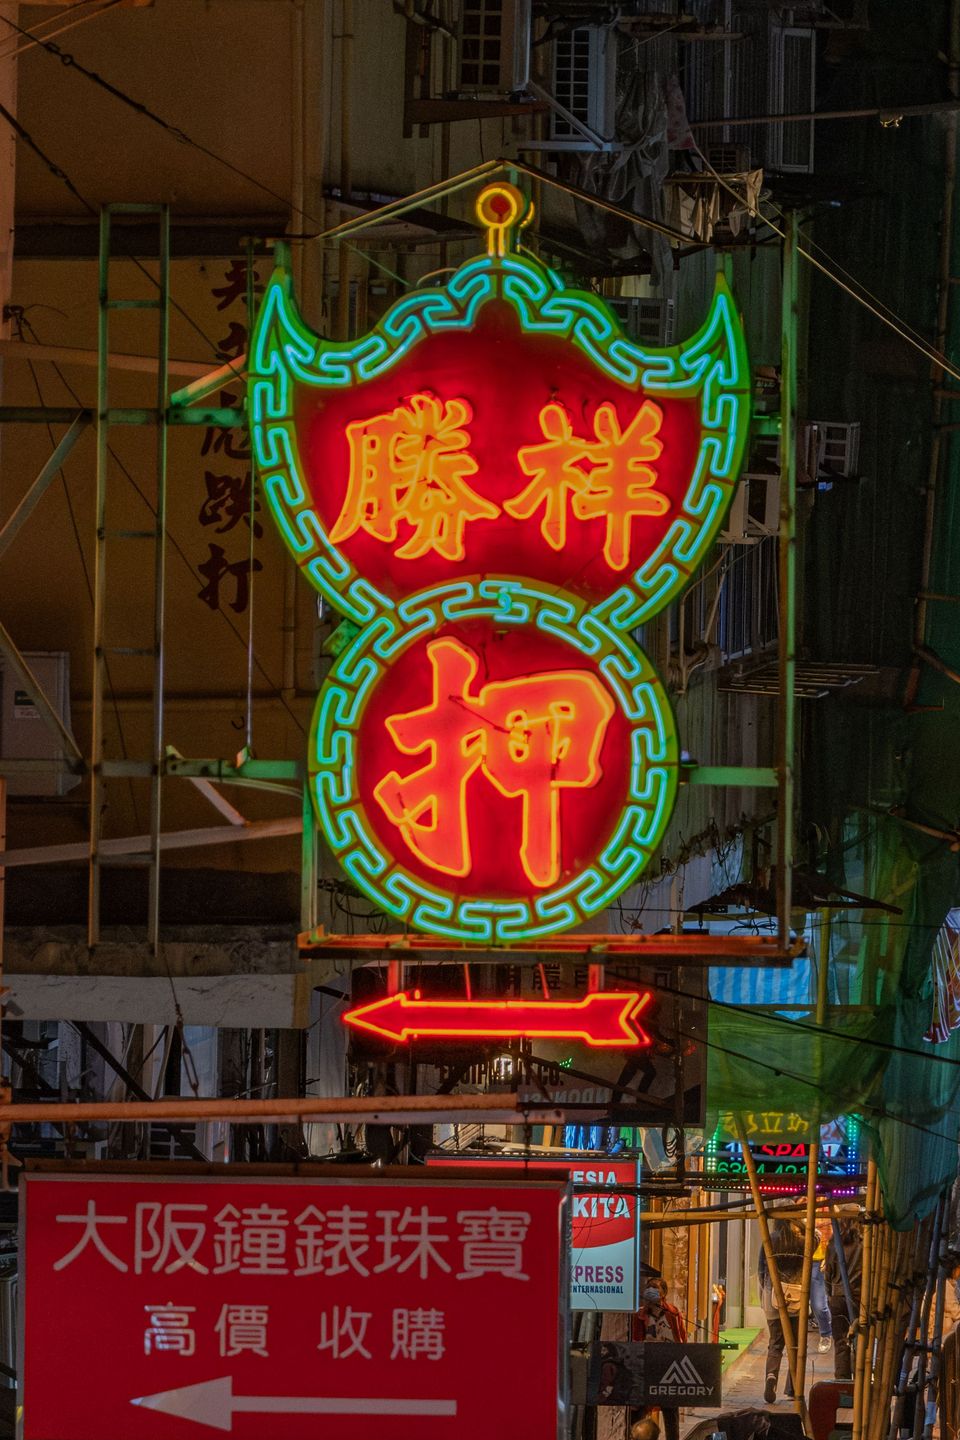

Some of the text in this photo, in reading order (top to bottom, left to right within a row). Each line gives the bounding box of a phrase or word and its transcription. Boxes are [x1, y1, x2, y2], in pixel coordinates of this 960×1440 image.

[372, 635, 617, 888] 押
[572, 1197, 631, 1219] KITA
[52, 1199, 532, 1283] 大阪鐘錶珠寶
[142, 1302, 448, 1361] 高價 收購
[649, 1385, 715, 1396] GREGORY
